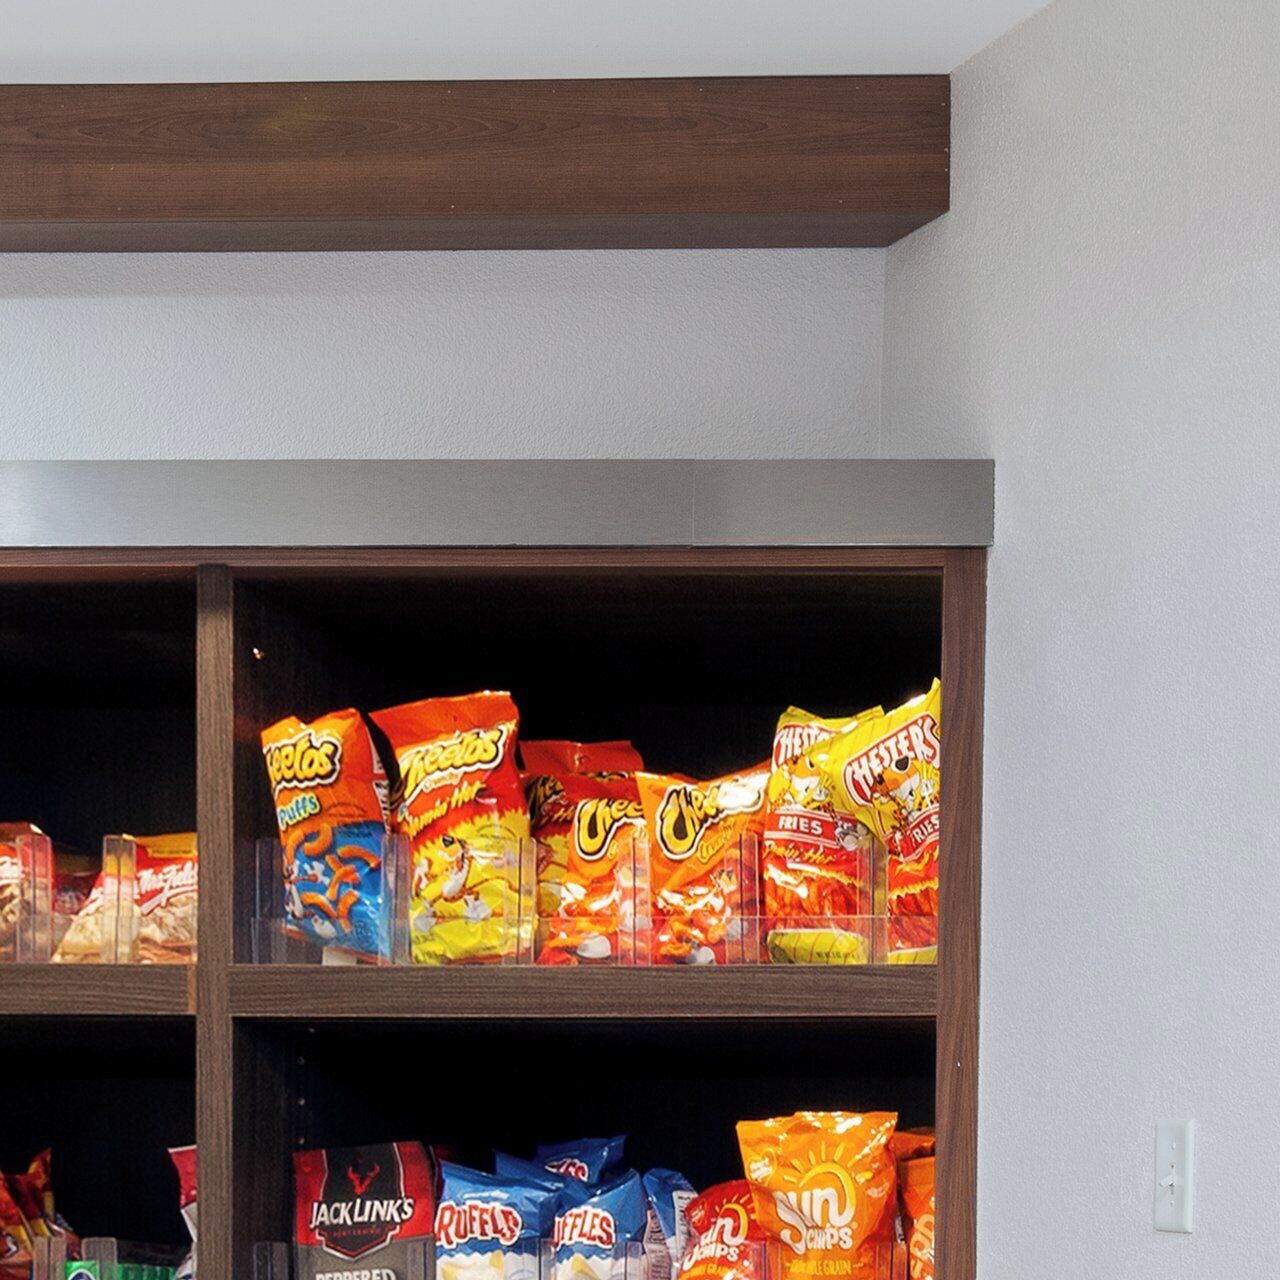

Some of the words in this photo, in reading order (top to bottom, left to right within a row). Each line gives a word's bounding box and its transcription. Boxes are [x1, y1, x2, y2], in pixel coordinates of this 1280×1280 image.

[267, 733, 337, 785] eetos
[278, 794, 320, 829] Puffs
[577, 799, 643, 857] Chee
[778, 814, 824, 836] FRIES
[309, 1202, 352, 1230] JACK
[436, 1202, 521, 1247] RUFFLS
[553, 1208, 614, 1248] UFFLES
